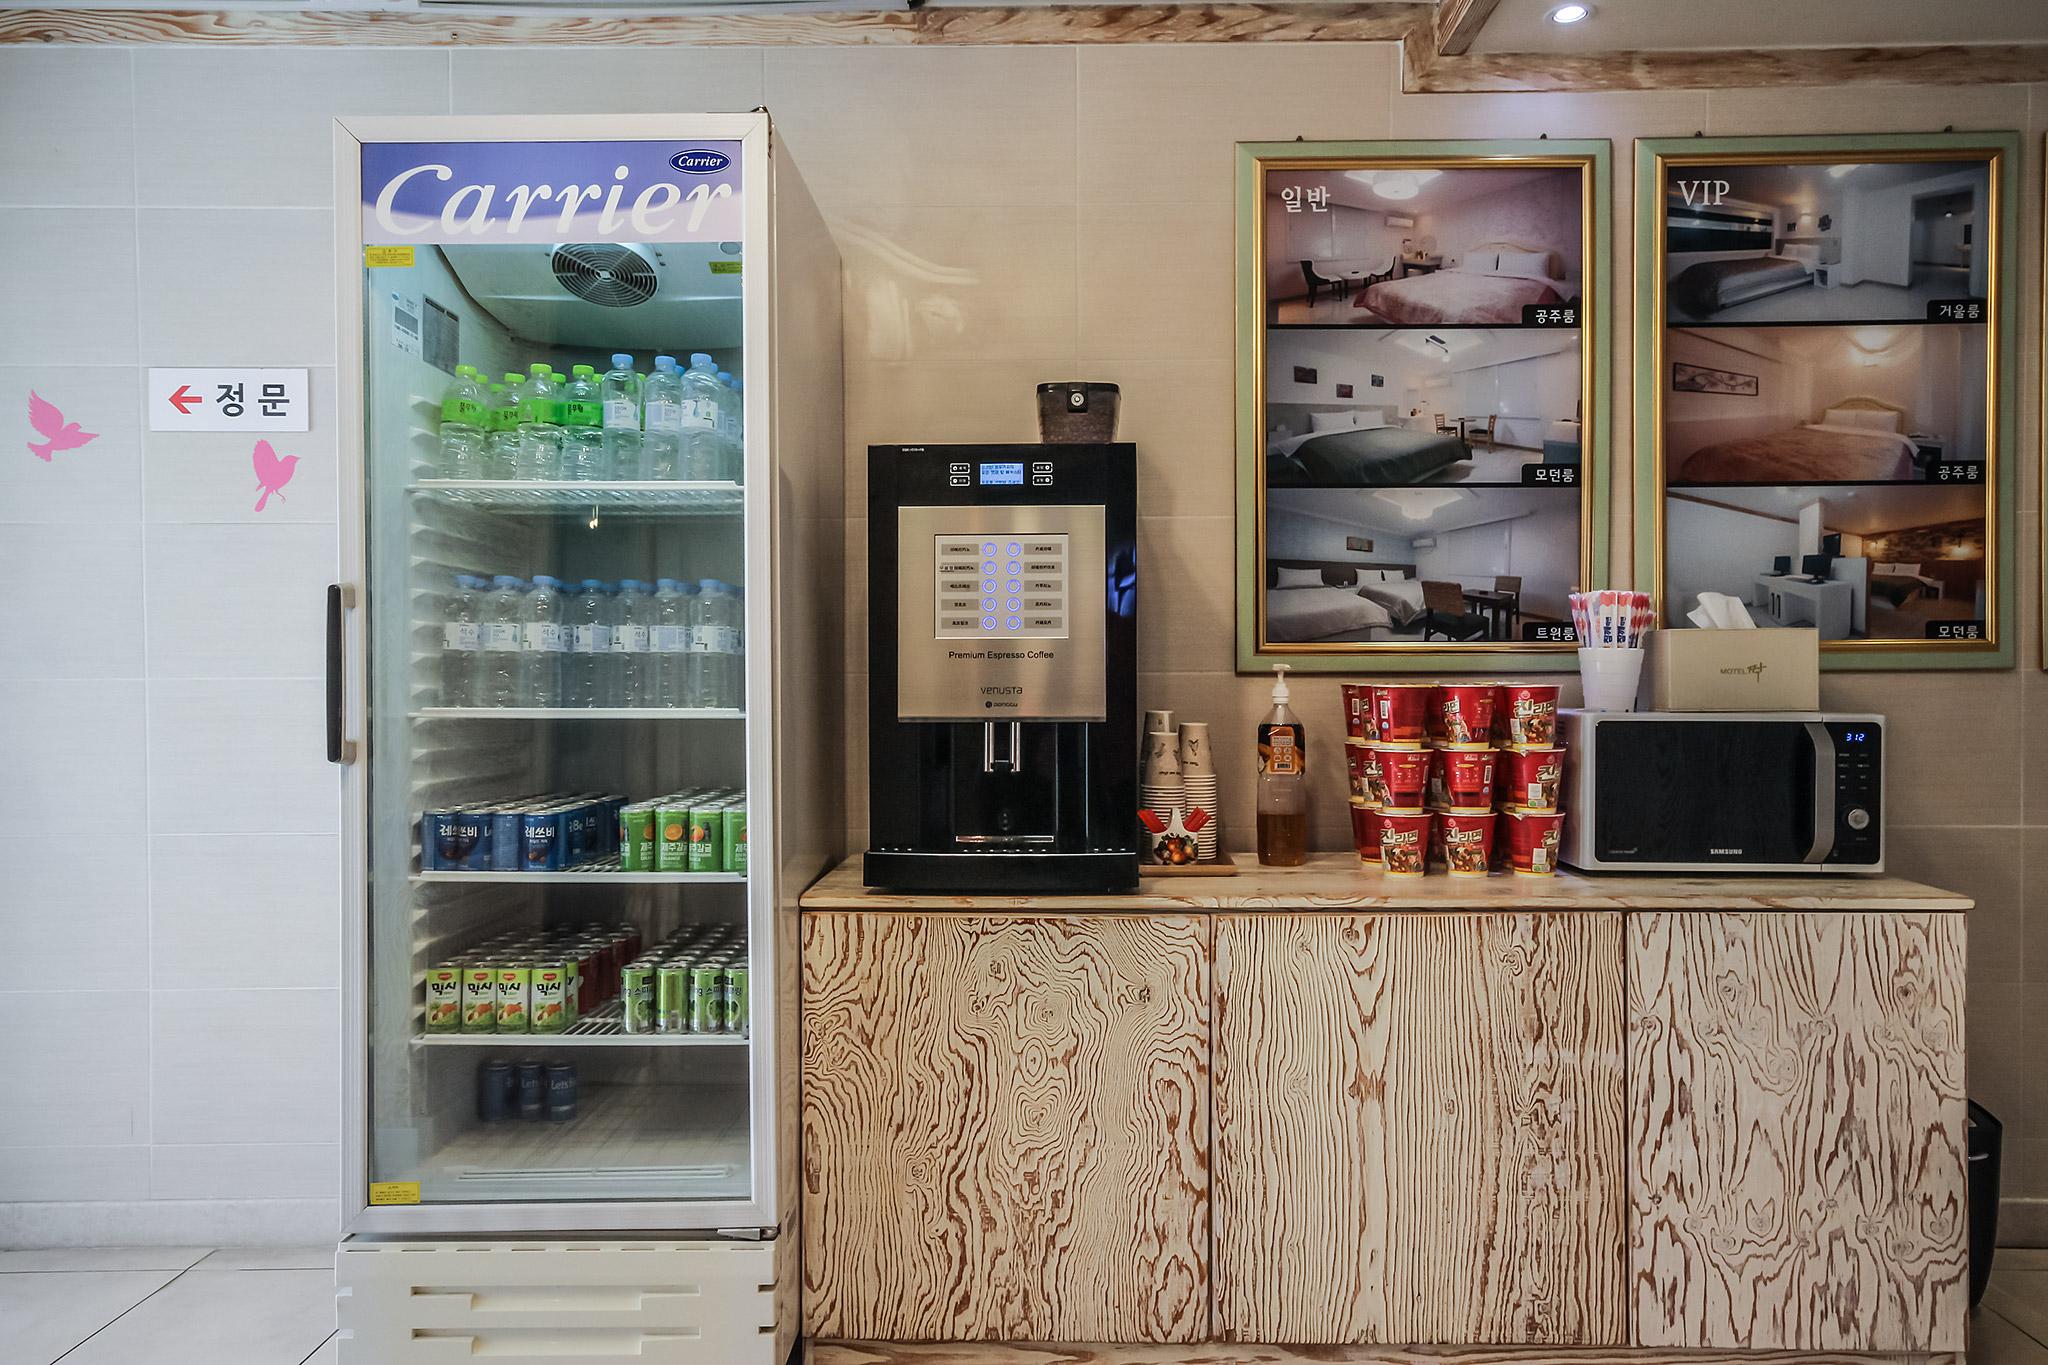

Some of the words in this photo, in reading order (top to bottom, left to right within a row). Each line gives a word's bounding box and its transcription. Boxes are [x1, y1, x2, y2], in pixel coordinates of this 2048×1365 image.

[678, 156, 723, 167] Carrier
[375, 164, 733, 236] Carrier
[1280, 185, 1331, 213] 일반
[1678, 180, 1730, 206] VIP
[1535, 309, 1576, 324] 공주룸
[1939, 304, 1980, 319] 거울룸
[1535, 468, 1575, 483] 모던룸
[1938, 465, 1978, 480] 공주룸
[1938, 625, 1978, 640] 모던룸
[948, 651, 985, 659] Premium
[987, 651, 1025, 661] Espresso
[1027, 651, 1054, 659] Coffee
